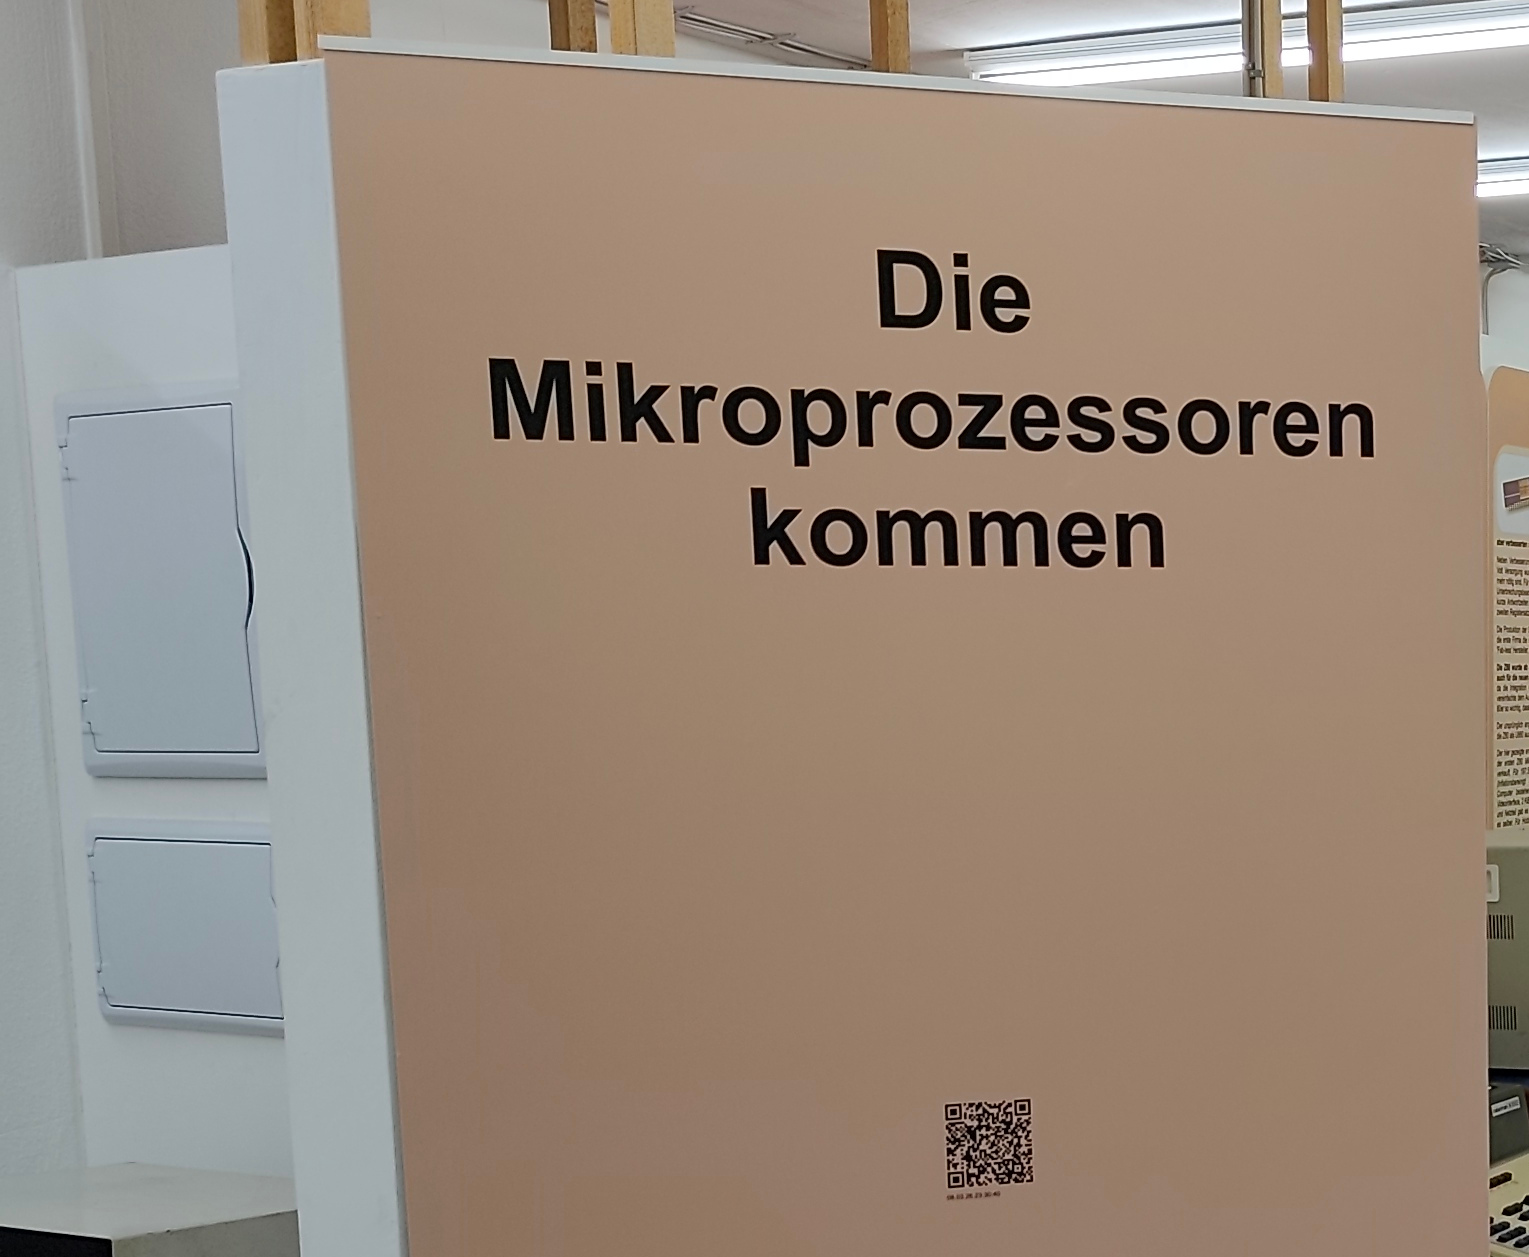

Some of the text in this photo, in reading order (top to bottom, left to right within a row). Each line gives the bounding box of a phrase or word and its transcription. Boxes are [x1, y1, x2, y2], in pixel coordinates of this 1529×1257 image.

[876, 249, 1031, 334] Die
[488, 357, 1375, 468] Mikroprozessoren
[750, 487, 1165, 569] kommen
